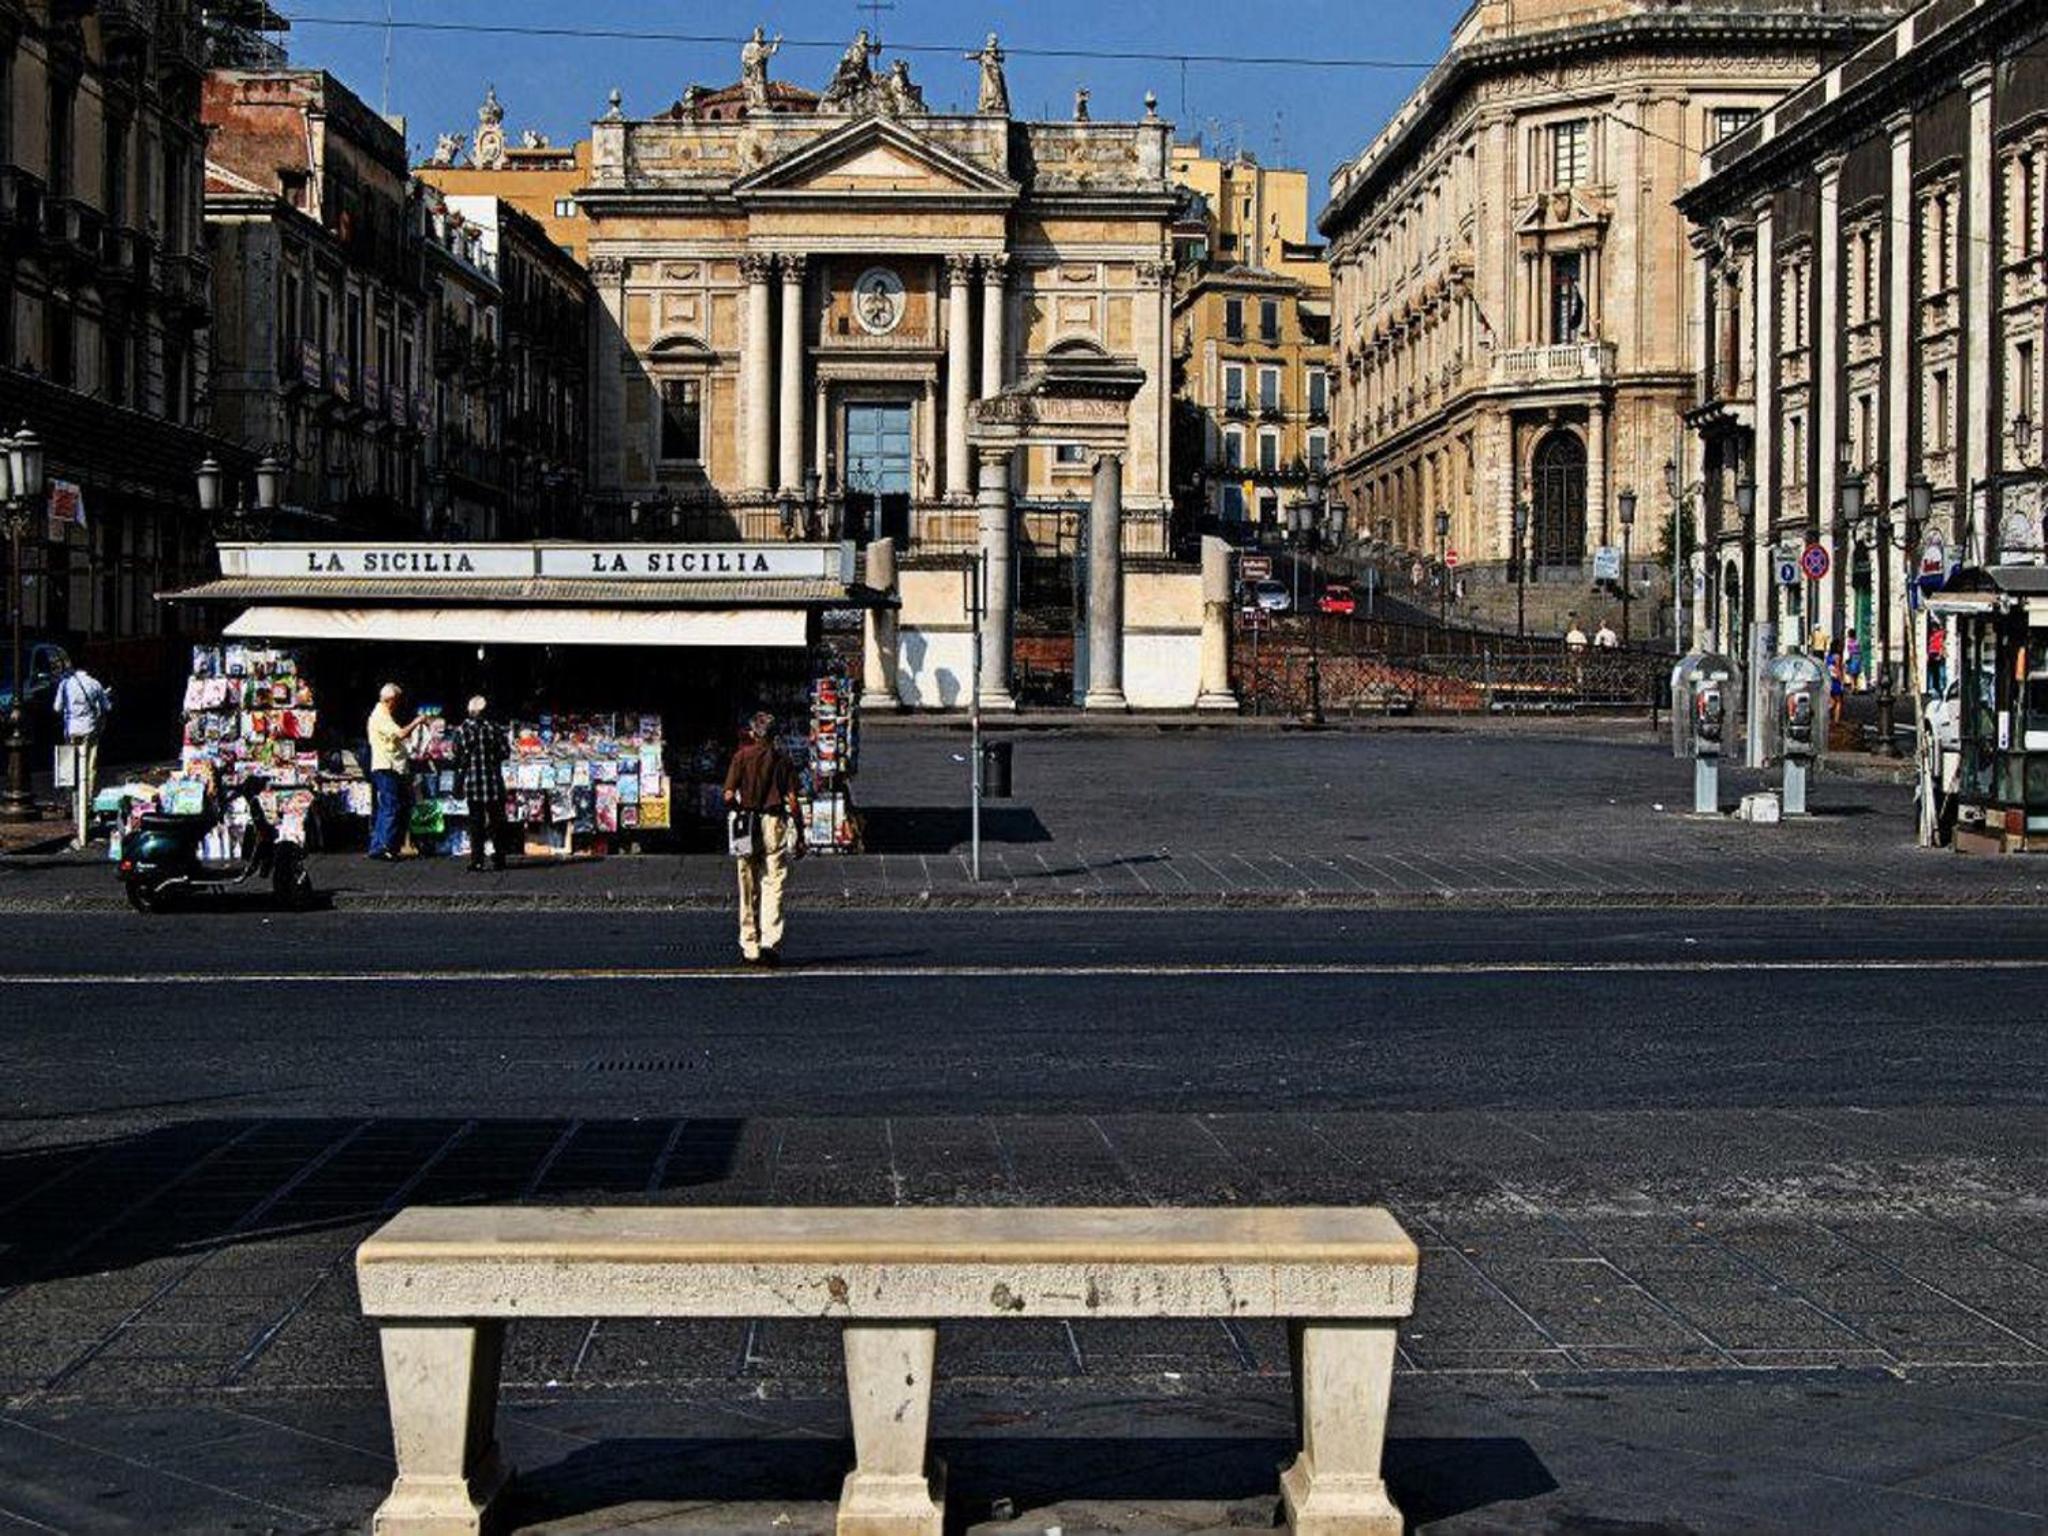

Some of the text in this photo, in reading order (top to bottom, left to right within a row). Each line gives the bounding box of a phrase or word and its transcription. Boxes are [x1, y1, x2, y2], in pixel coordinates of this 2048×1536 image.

[308, 552, 474, 572] LA SICILIA
[592, 552, 768, 572] LA SICILIA
